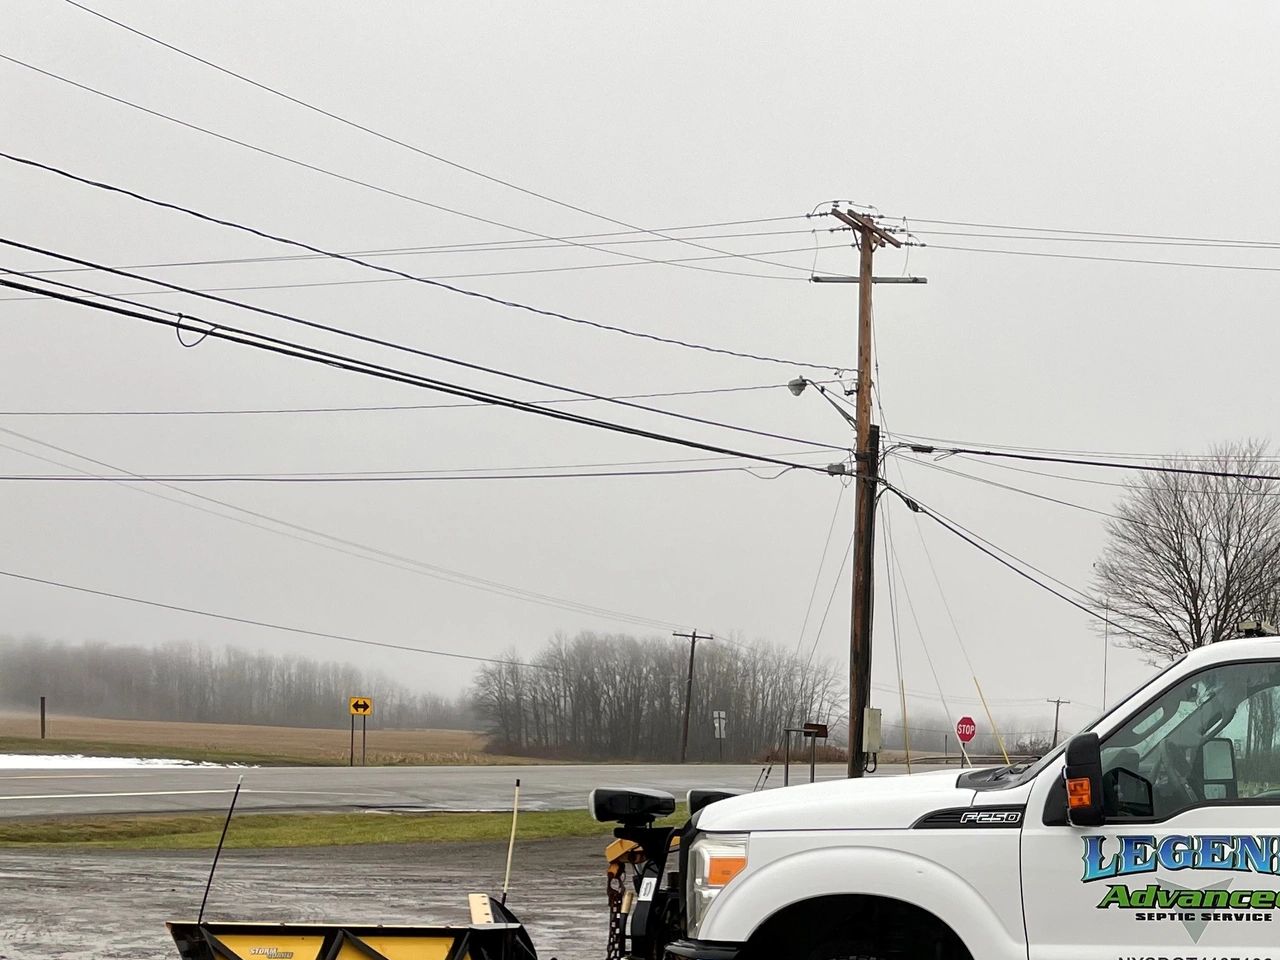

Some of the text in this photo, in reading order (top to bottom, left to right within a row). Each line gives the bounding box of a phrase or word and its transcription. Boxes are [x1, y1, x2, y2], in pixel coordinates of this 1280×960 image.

[958, 724, 975, 735] STOP
[1135, 912, 1272, 922] SEPTIC SERVICE
